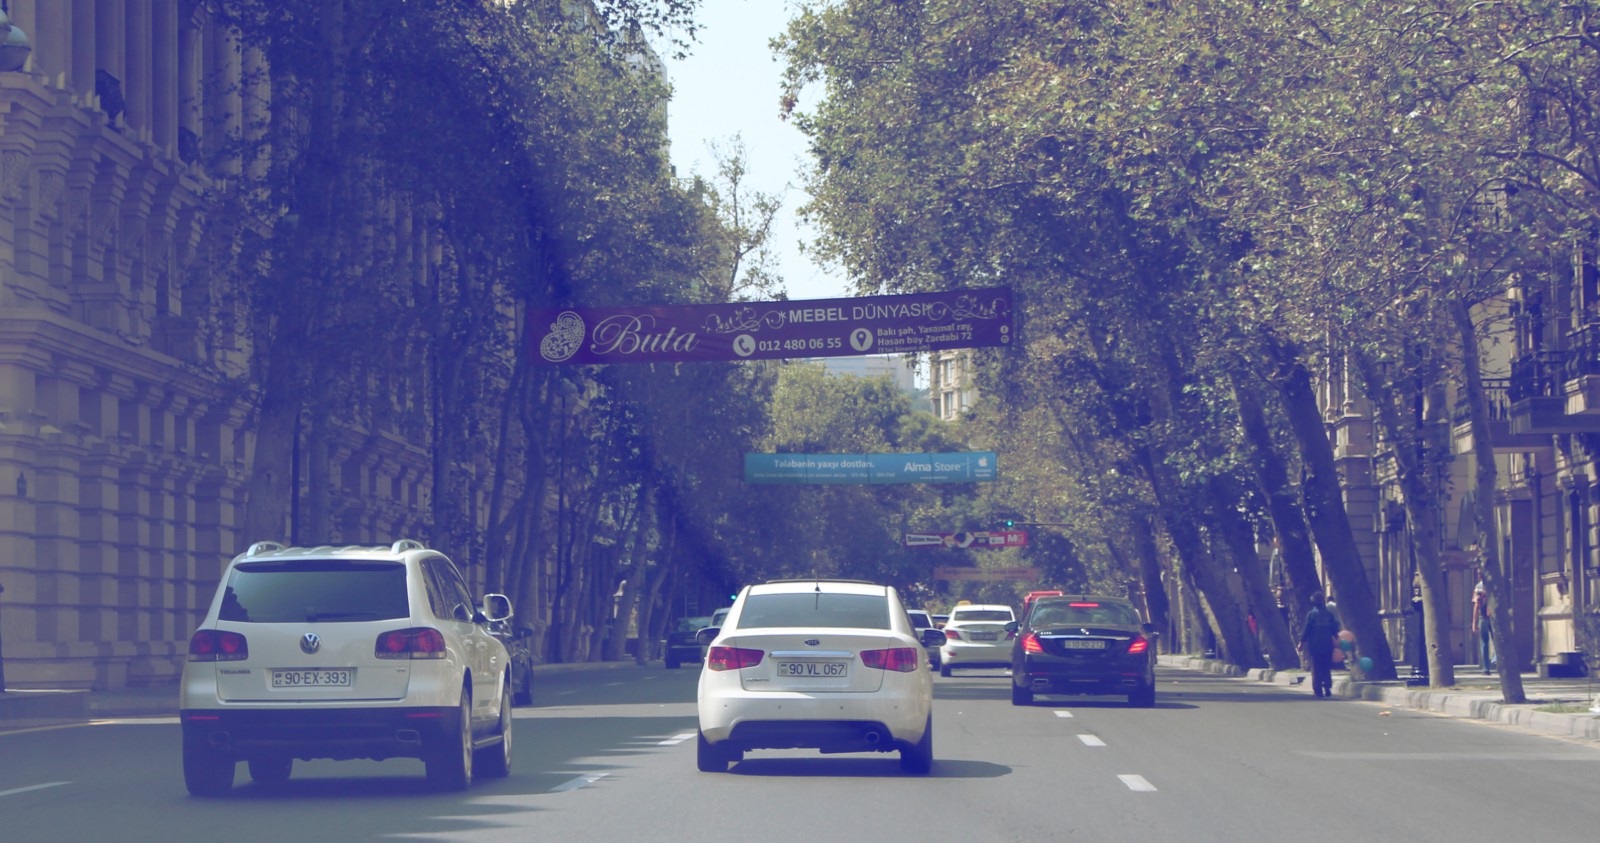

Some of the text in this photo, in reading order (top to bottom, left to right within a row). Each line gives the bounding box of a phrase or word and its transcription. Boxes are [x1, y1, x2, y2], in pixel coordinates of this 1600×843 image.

[789, 303, 925, 323] MEBEL DÜNYASI
[590, 314, 700, 355] Buta
[877, 328, 896, 337] Bakı
[961, 331, 972, 340] 72
[759, 338, 842, 351] 012 480 06 55
[904, 462, 960, 472] Alma Store
[789, 664, 803, 674] 90
[807, 664, 820, 675] VL
[824, 664, 845, 675] 067
[285, 672, 347, 685] 90-EX-393
